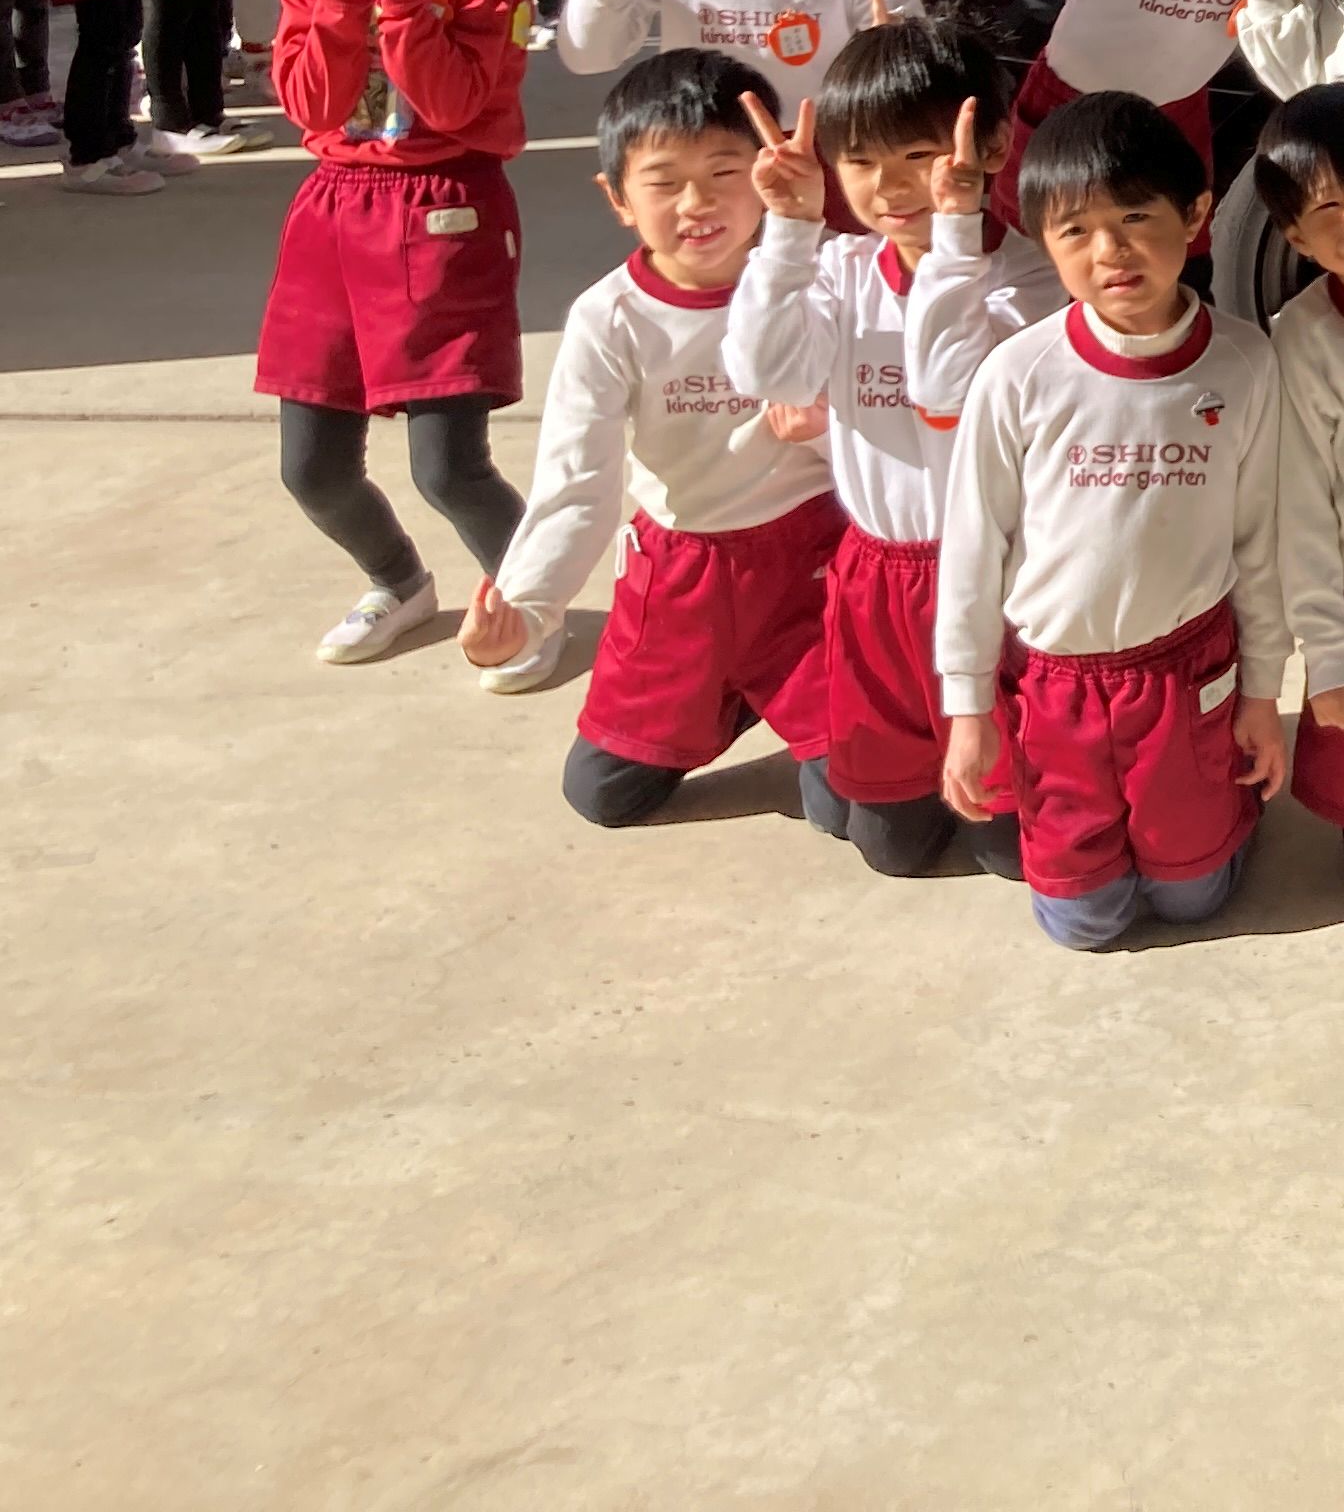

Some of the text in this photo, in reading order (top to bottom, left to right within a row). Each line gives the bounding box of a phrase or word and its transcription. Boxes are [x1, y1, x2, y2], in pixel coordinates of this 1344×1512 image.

[701, 27, 769, 49] kinderg
[666, 396, 761, 415] kindergar
[1092, 444, 1213, 464] SHION
[1070, 468, 1206, 490] kindergarten
